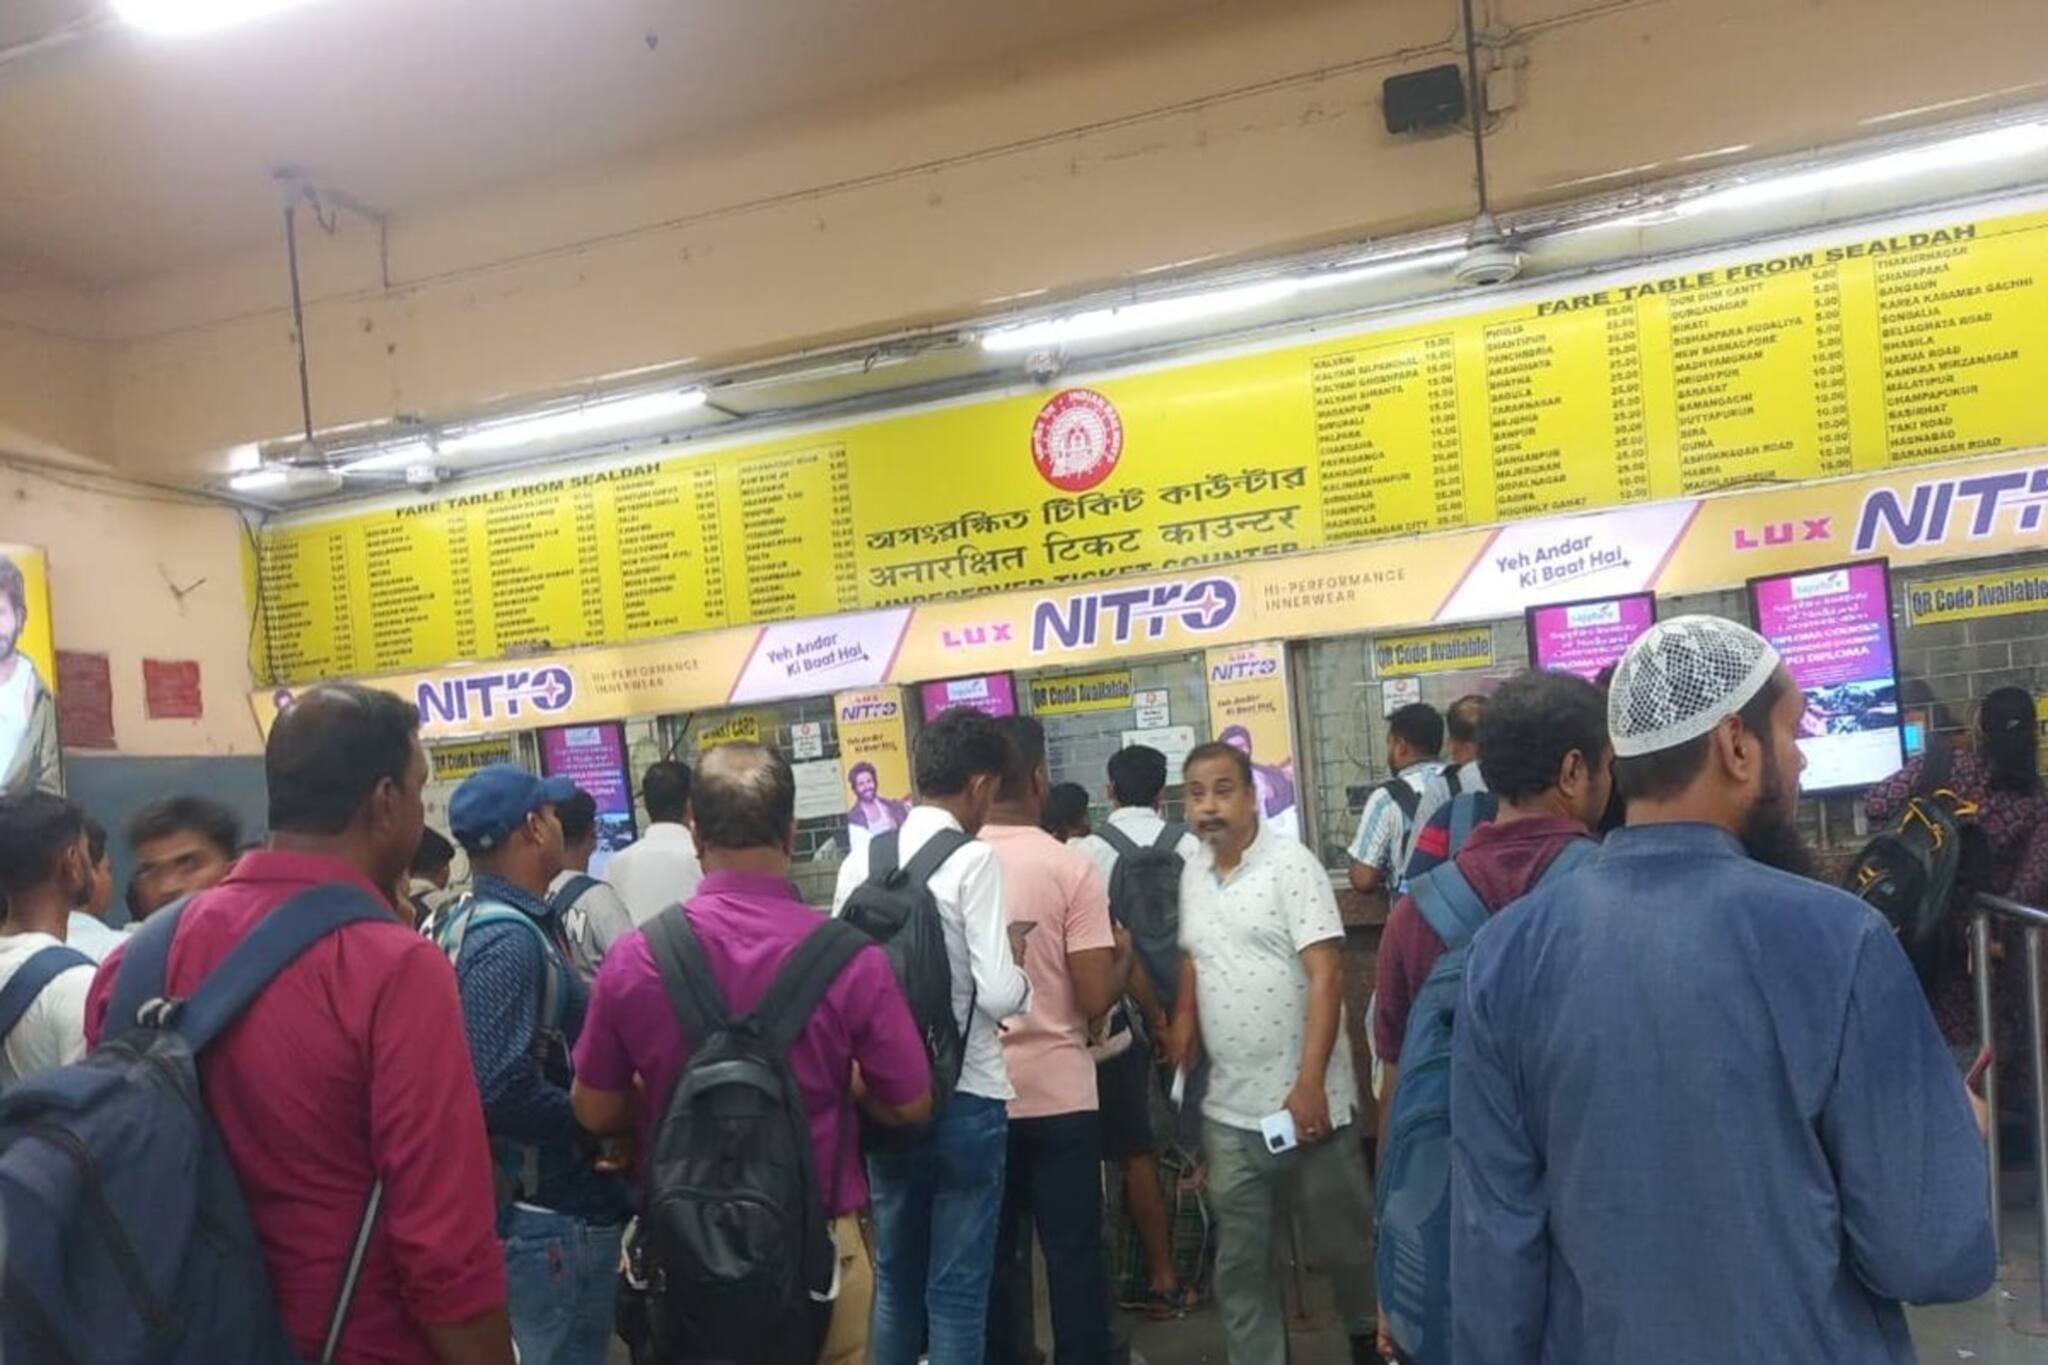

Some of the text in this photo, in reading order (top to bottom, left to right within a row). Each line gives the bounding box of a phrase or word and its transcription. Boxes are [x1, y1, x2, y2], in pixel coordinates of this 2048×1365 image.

[1537, 224, 1977, 316] FARE TABLE FROM SEALDAH
[395, 461, 662, 519] FARE TABLE FROM SEALDAH
[866, 465, 1307, 550] অসংরক্ষিত টিকিট কাউন্টার
[1734, 468, 2048, 552] LUX NITR
[868, 505, 1300, 588] अनारक्षित टिकट काउन्टर
[1496, 532, 1594, 575] Yeh Andar
[1519, 546, 1624, 589] Ki Baat Hai
[1264, 568, 1406, 597] HI-PERFORMANCE
[1265, 589, 1357, 611] INNERWEAR
[1912, 577, 2048, 617] QR Code Available
[943, 578, 1237, 652] LUX NITRO
[767, 634, 838, 664] Yeh Andar
[786, 645, 863, 677] Ki Baat Hai
[1212, 659, 1276, 681] NITRO
[416, 668, 574, 724] NITRO
[842, 702, 897, 720] NITRO
